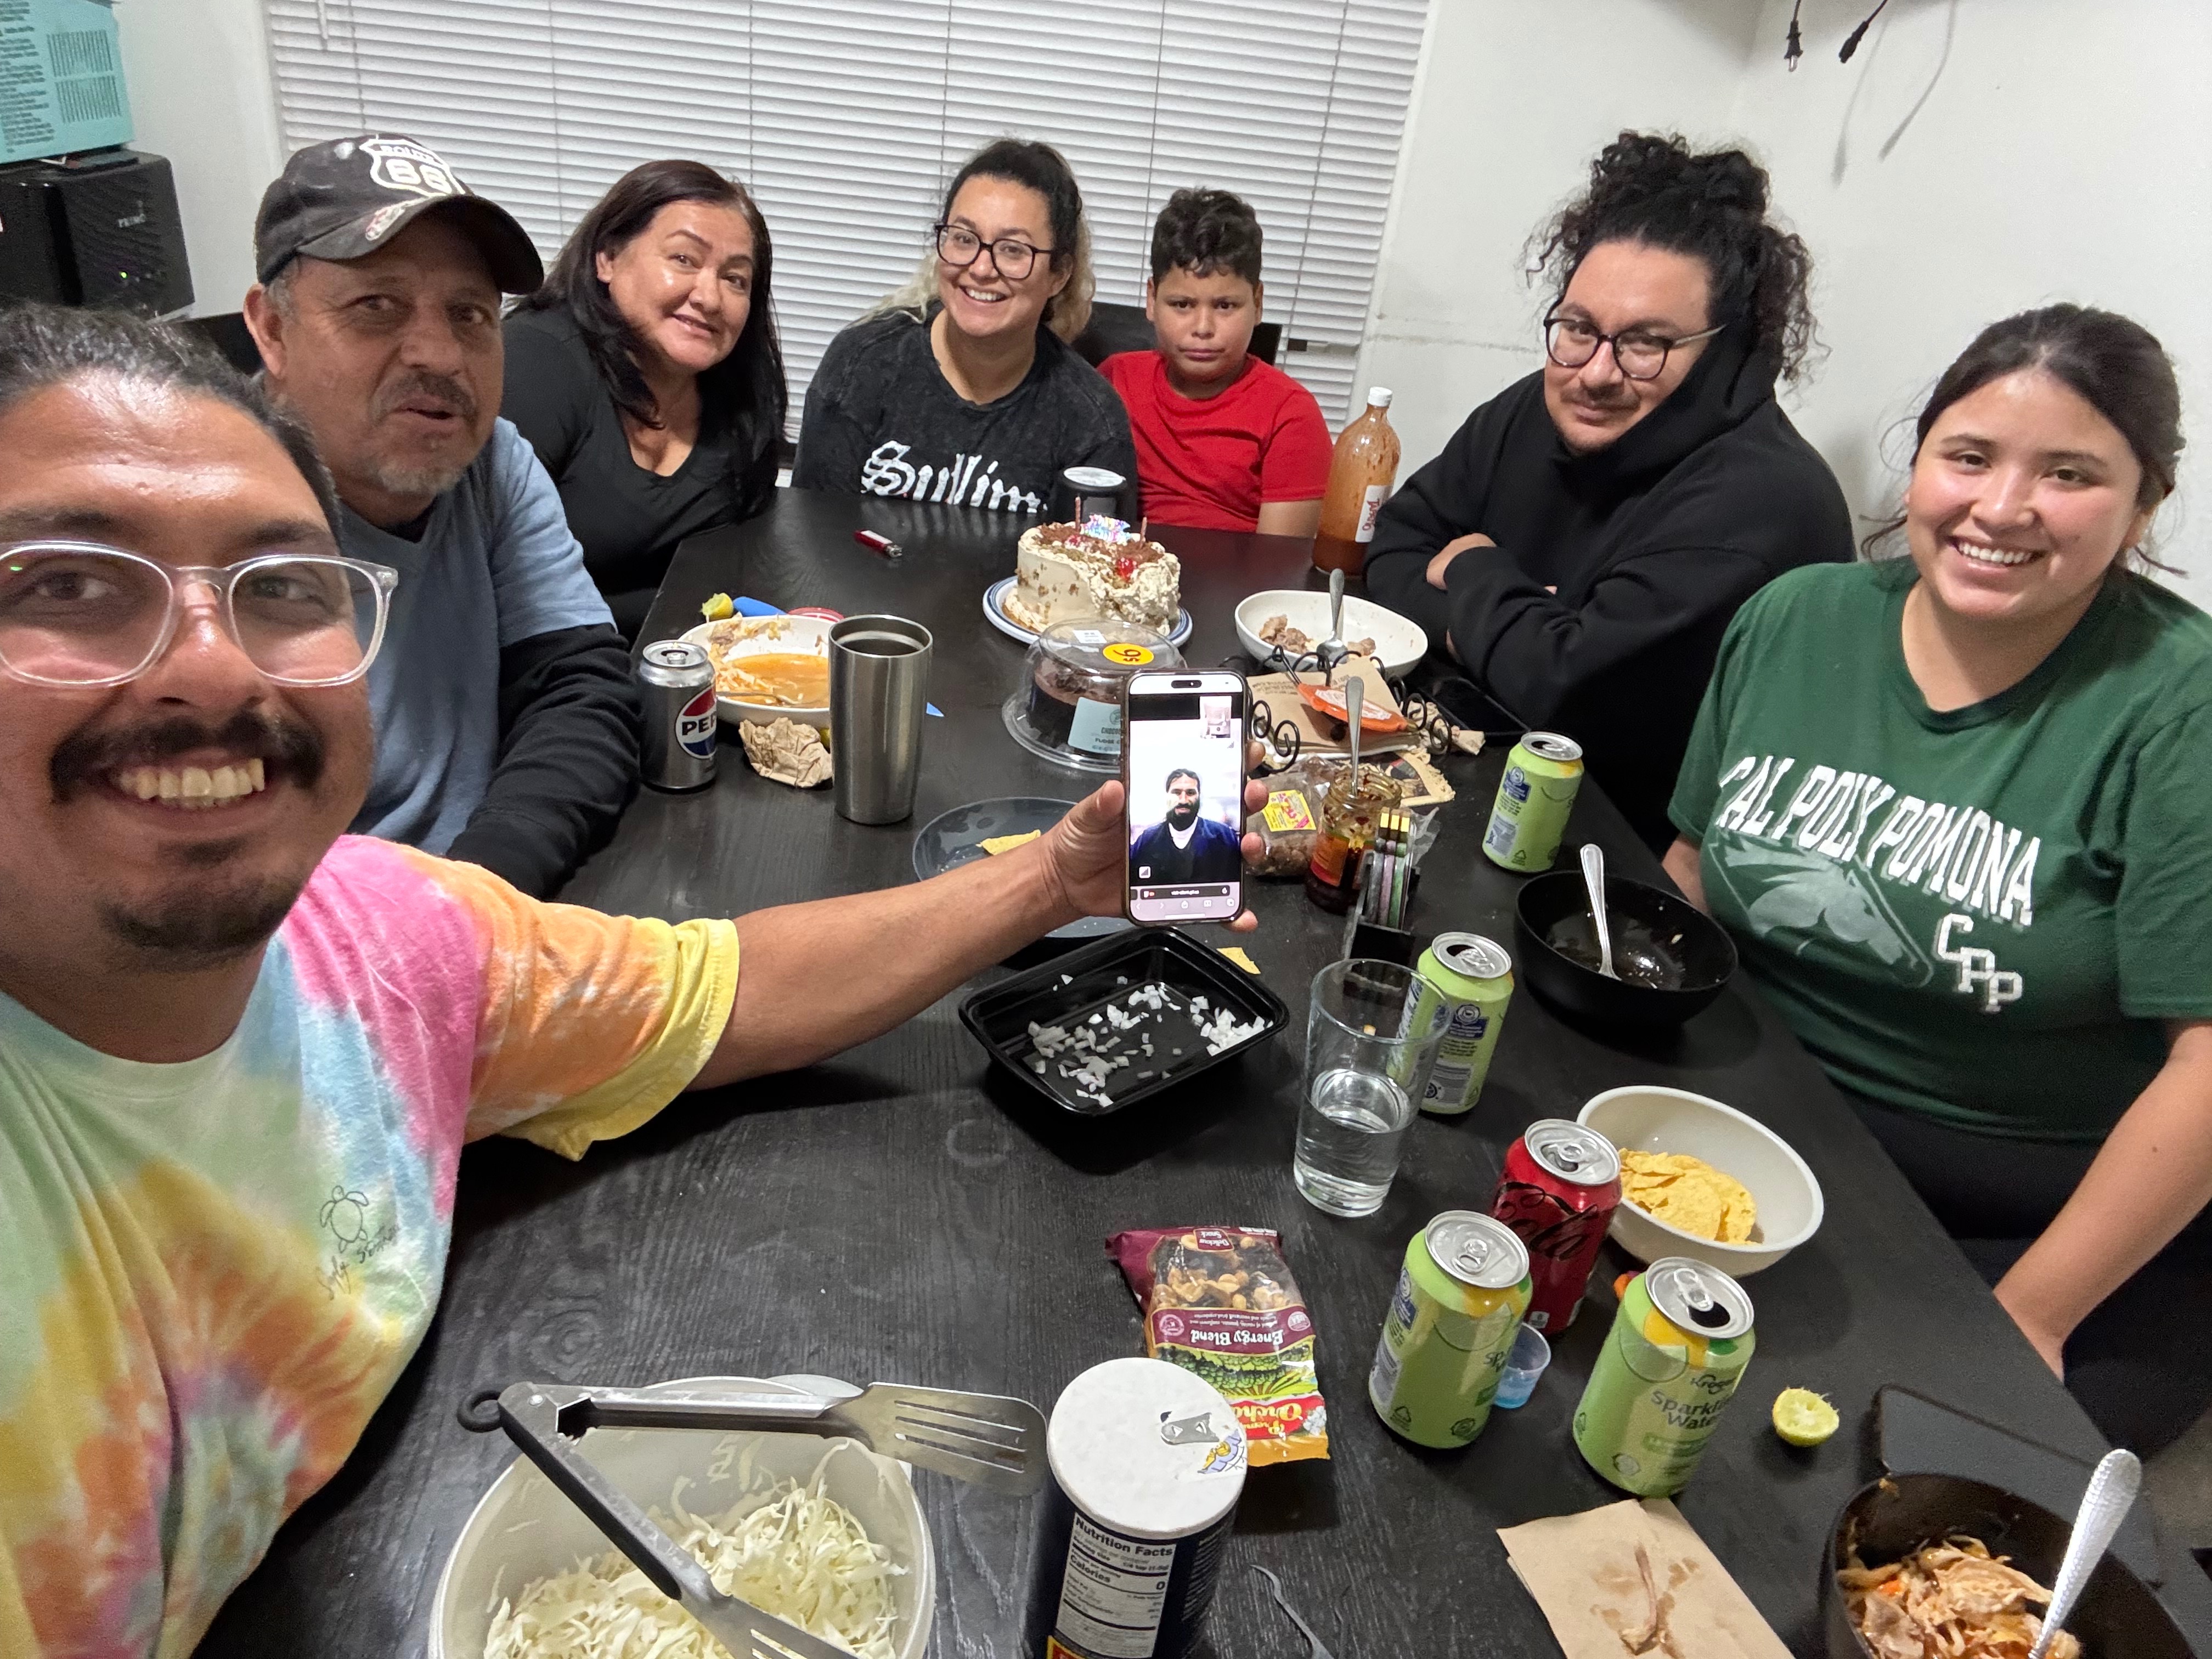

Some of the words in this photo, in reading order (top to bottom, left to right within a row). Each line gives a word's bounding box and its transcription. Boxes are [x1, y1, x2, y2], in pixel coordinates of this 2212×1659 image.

[1770, 764, 1896, 862] POLY
[1865, 795, 2041, 927] POMONA
[1936, 912, 2023, 1013] CPP
[1190, 1329, 1232, 1346] Blend
[1233, 1330, 1284, 1346] Energy
[1075, 1516, 1130, 1553] Nutrition
[1135, 1545, 1173, 1556] Facts
[1070, 1554, 1111, 1583] Calories
[1156, 1581, 1166, 1590] 0
